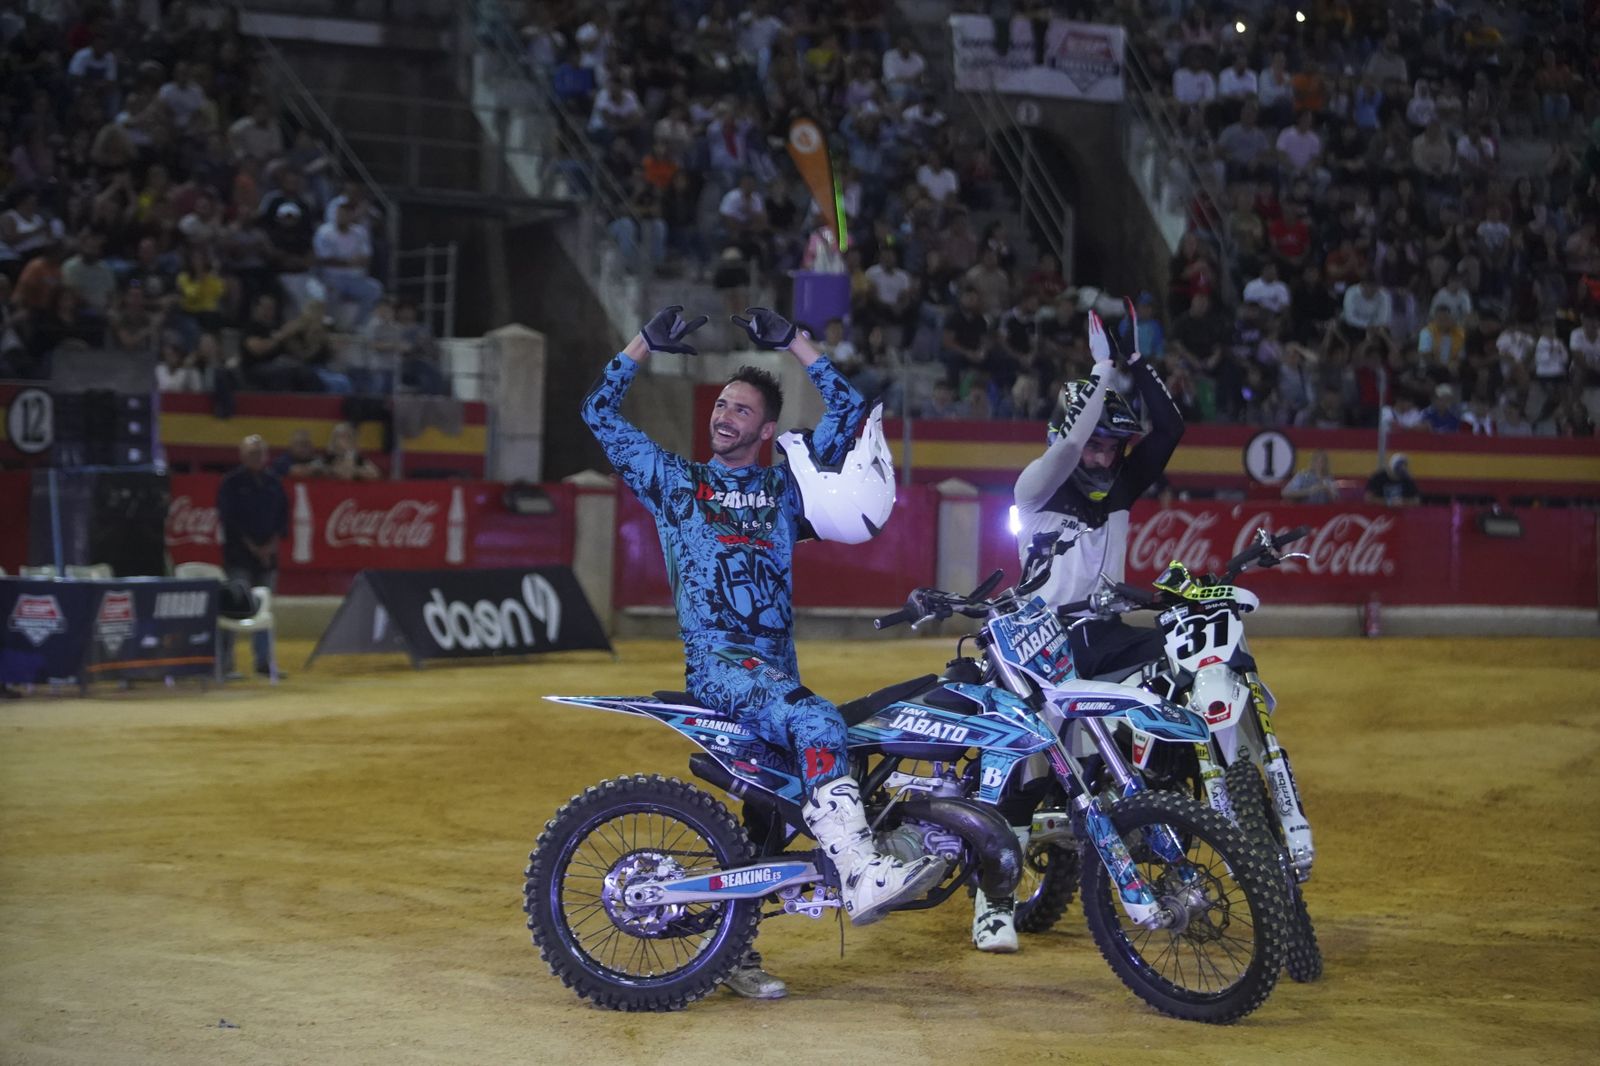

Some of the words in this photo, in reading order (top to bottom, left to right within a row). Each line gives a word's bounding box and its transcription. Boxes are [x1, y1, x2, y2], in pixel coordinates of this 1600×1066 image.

[22, 397, 45, 443] 12
[1261, 438, 1276, 478] 1
[325, 498, 440, 549] Coca-Cola
[1176, 612, 1229, 660] 31
[888, 713, 970, 743] JABATO
[899, 705, 929, 717] JAVI
[982, 766, 1003, 788] B
[1277, 771, 1293, 807] Arriba
